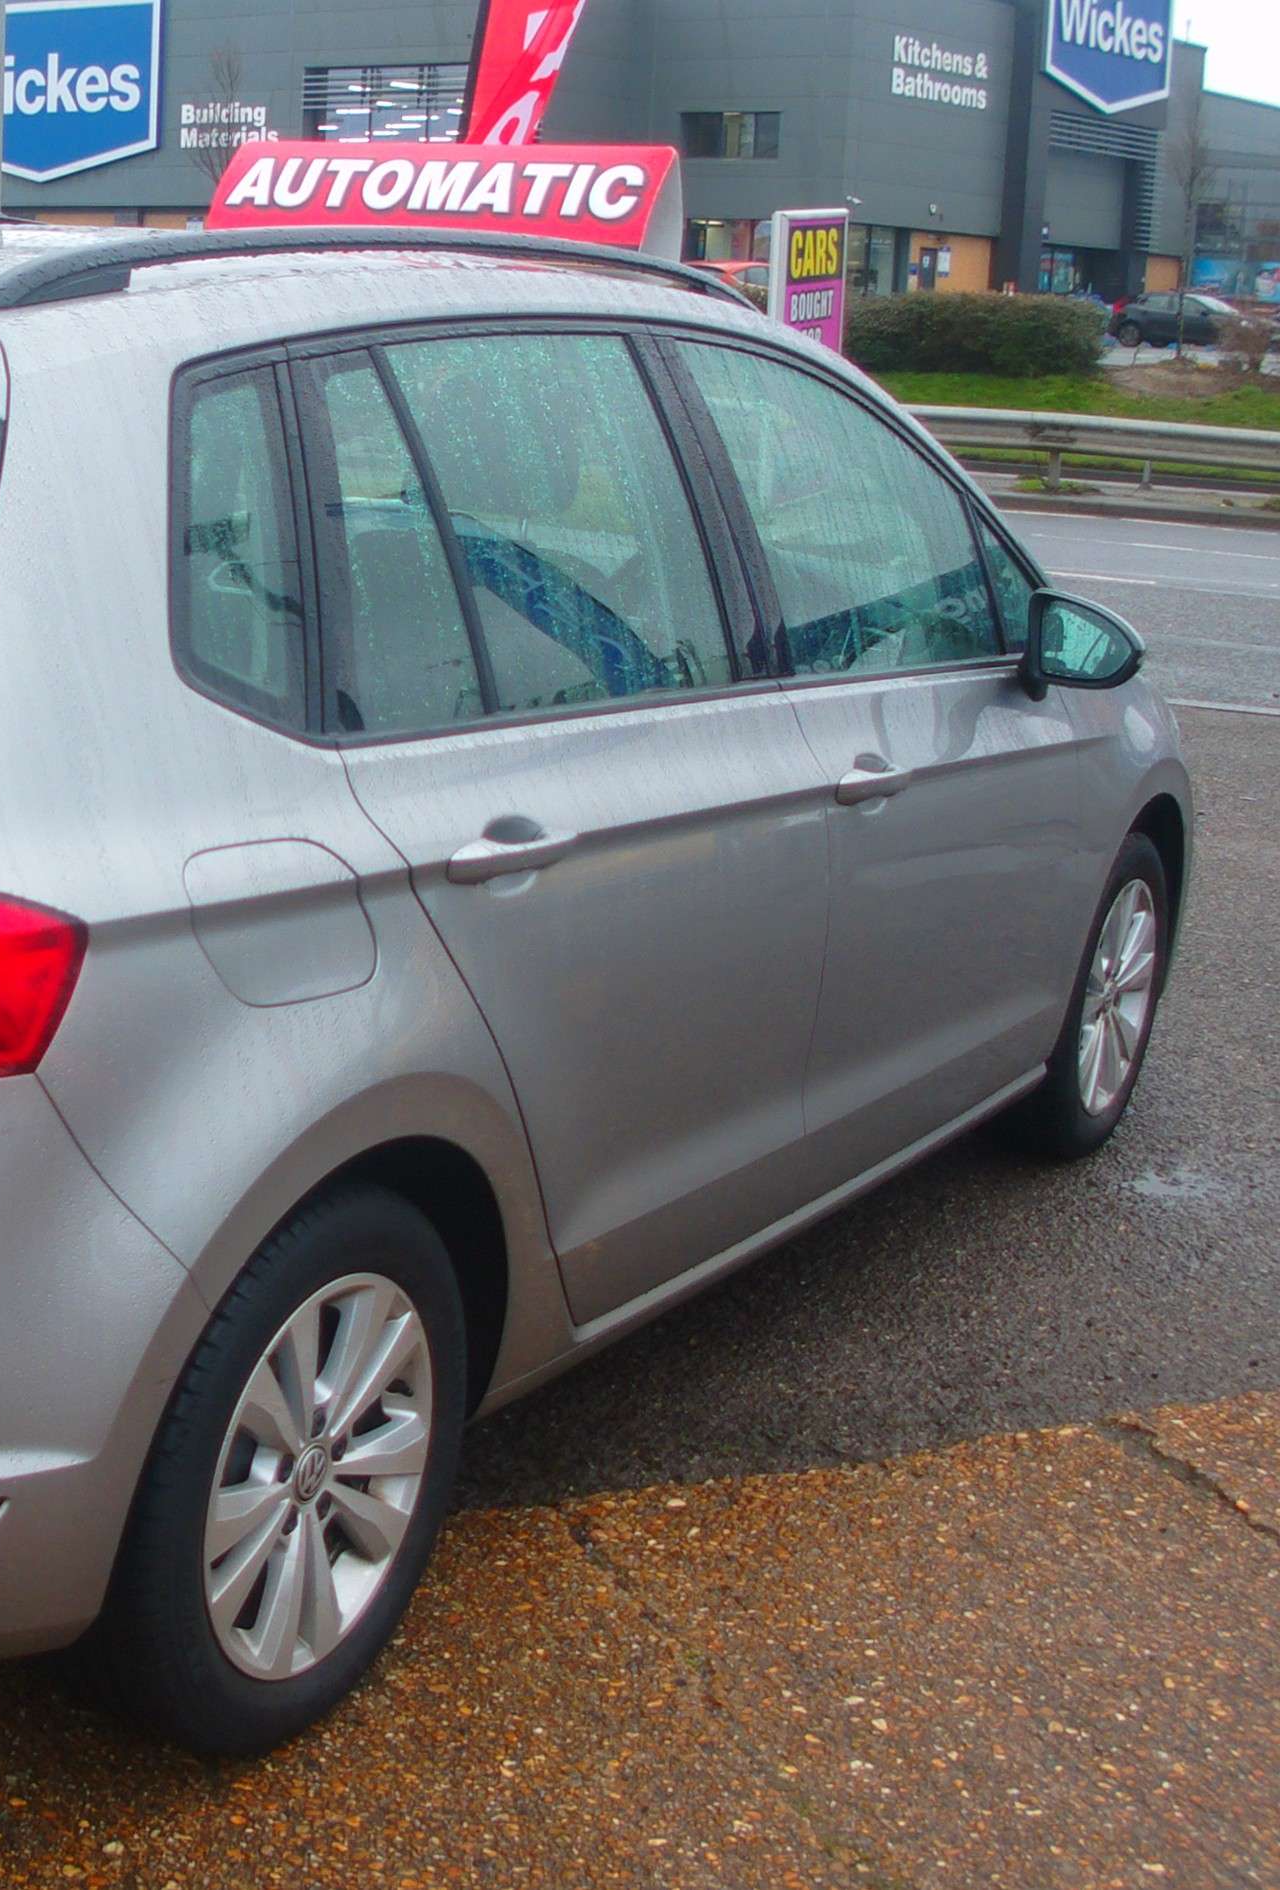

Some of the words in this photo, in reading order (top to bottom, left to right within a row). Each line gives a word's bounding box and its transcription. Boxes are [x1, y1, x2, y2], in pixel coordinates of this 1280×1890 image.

[1061, 0, 1163, 63] Wickes
[894, 35, 972, 76] Kitchens
[975, 53, 988, 78] &
[892, 67, 987, 109] Bathrooms
[181, 102, 266, 127] Building
[180, 126, 279, 148] Materials
[225, 157, 645, 220] AUTOMATIC
[790, 228, 838, 279] CARS
[790, 289, 833, 322] BOUGHT
